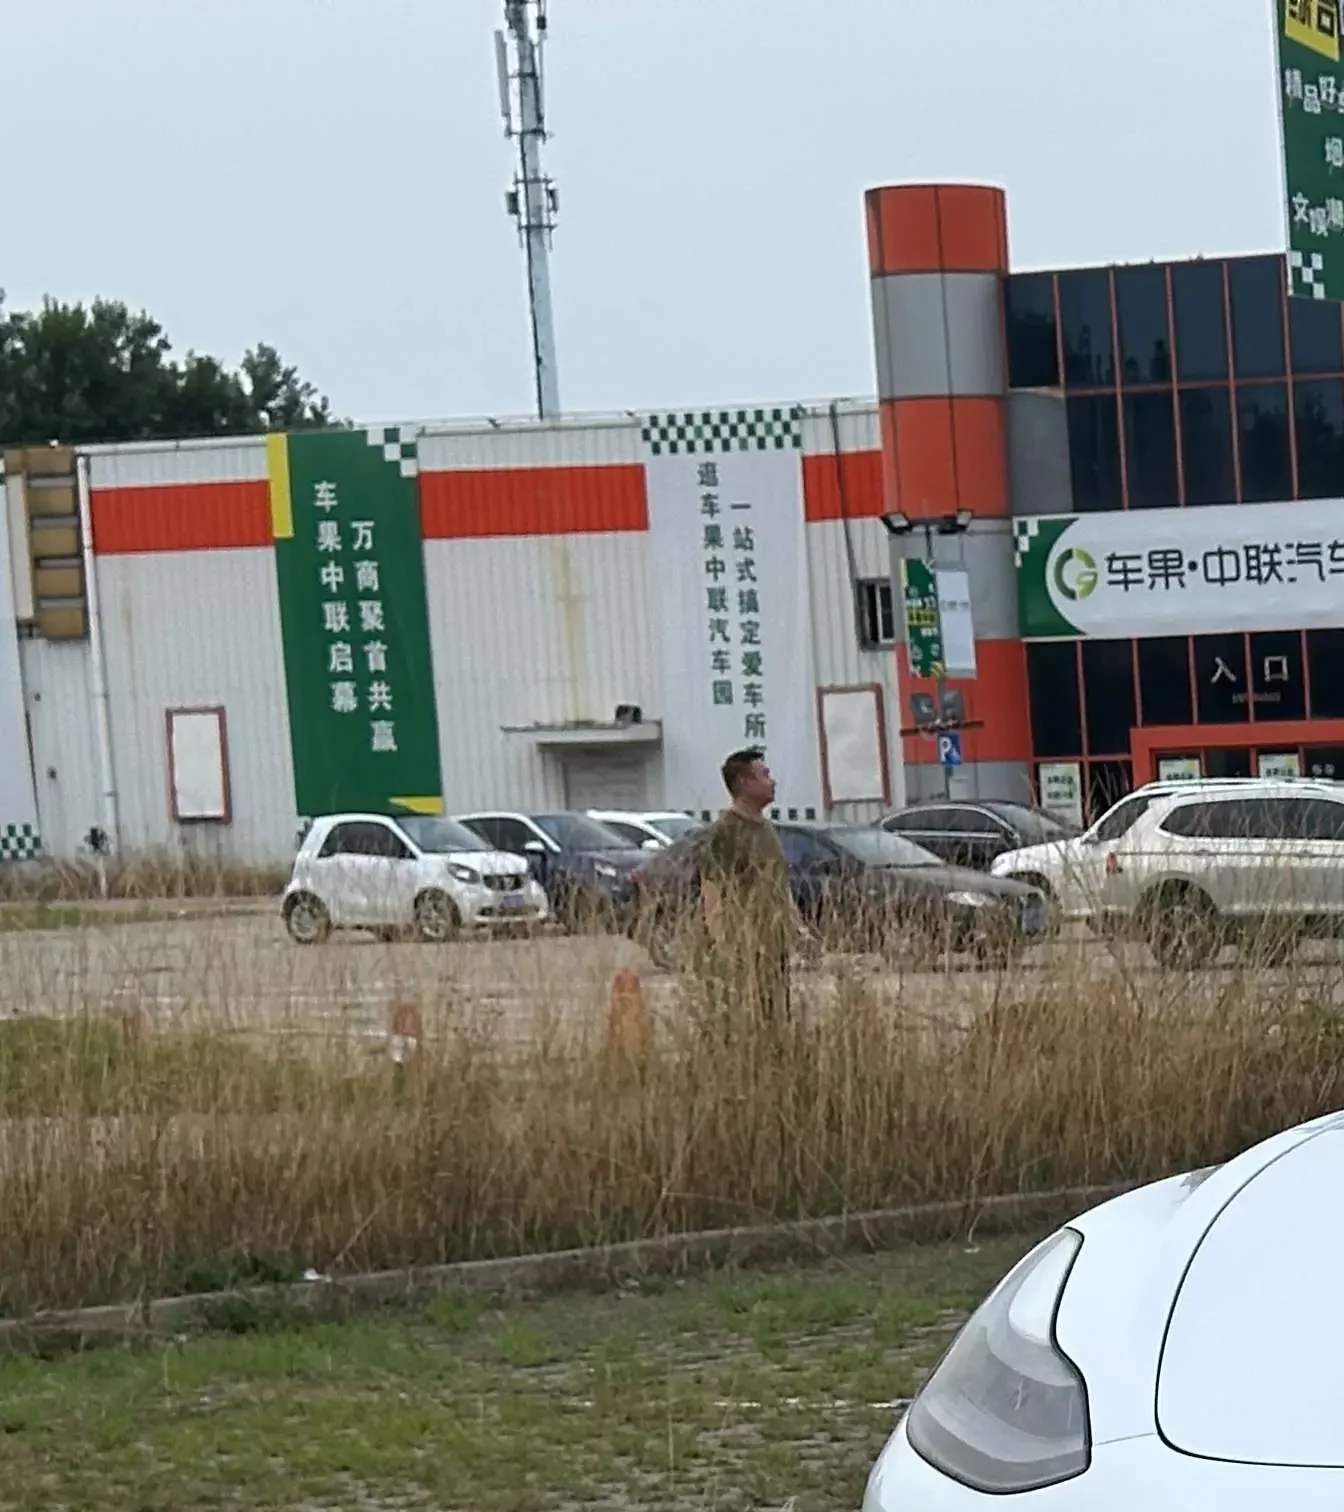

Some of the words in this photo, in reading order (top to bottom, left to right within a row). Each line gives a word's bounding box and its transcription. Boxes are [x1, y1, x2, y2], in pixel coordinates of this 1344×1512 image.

[314, 481, 358, 713] 车果中联启幕
[351, 521, 398, 751] 万商聚首共赢
[698, 461, 734, 705] 逛车果中联汽车园
[730, 503, 767, 757] 一站式搞定爱车所
[1211, 656, 1289, 683] 入口
